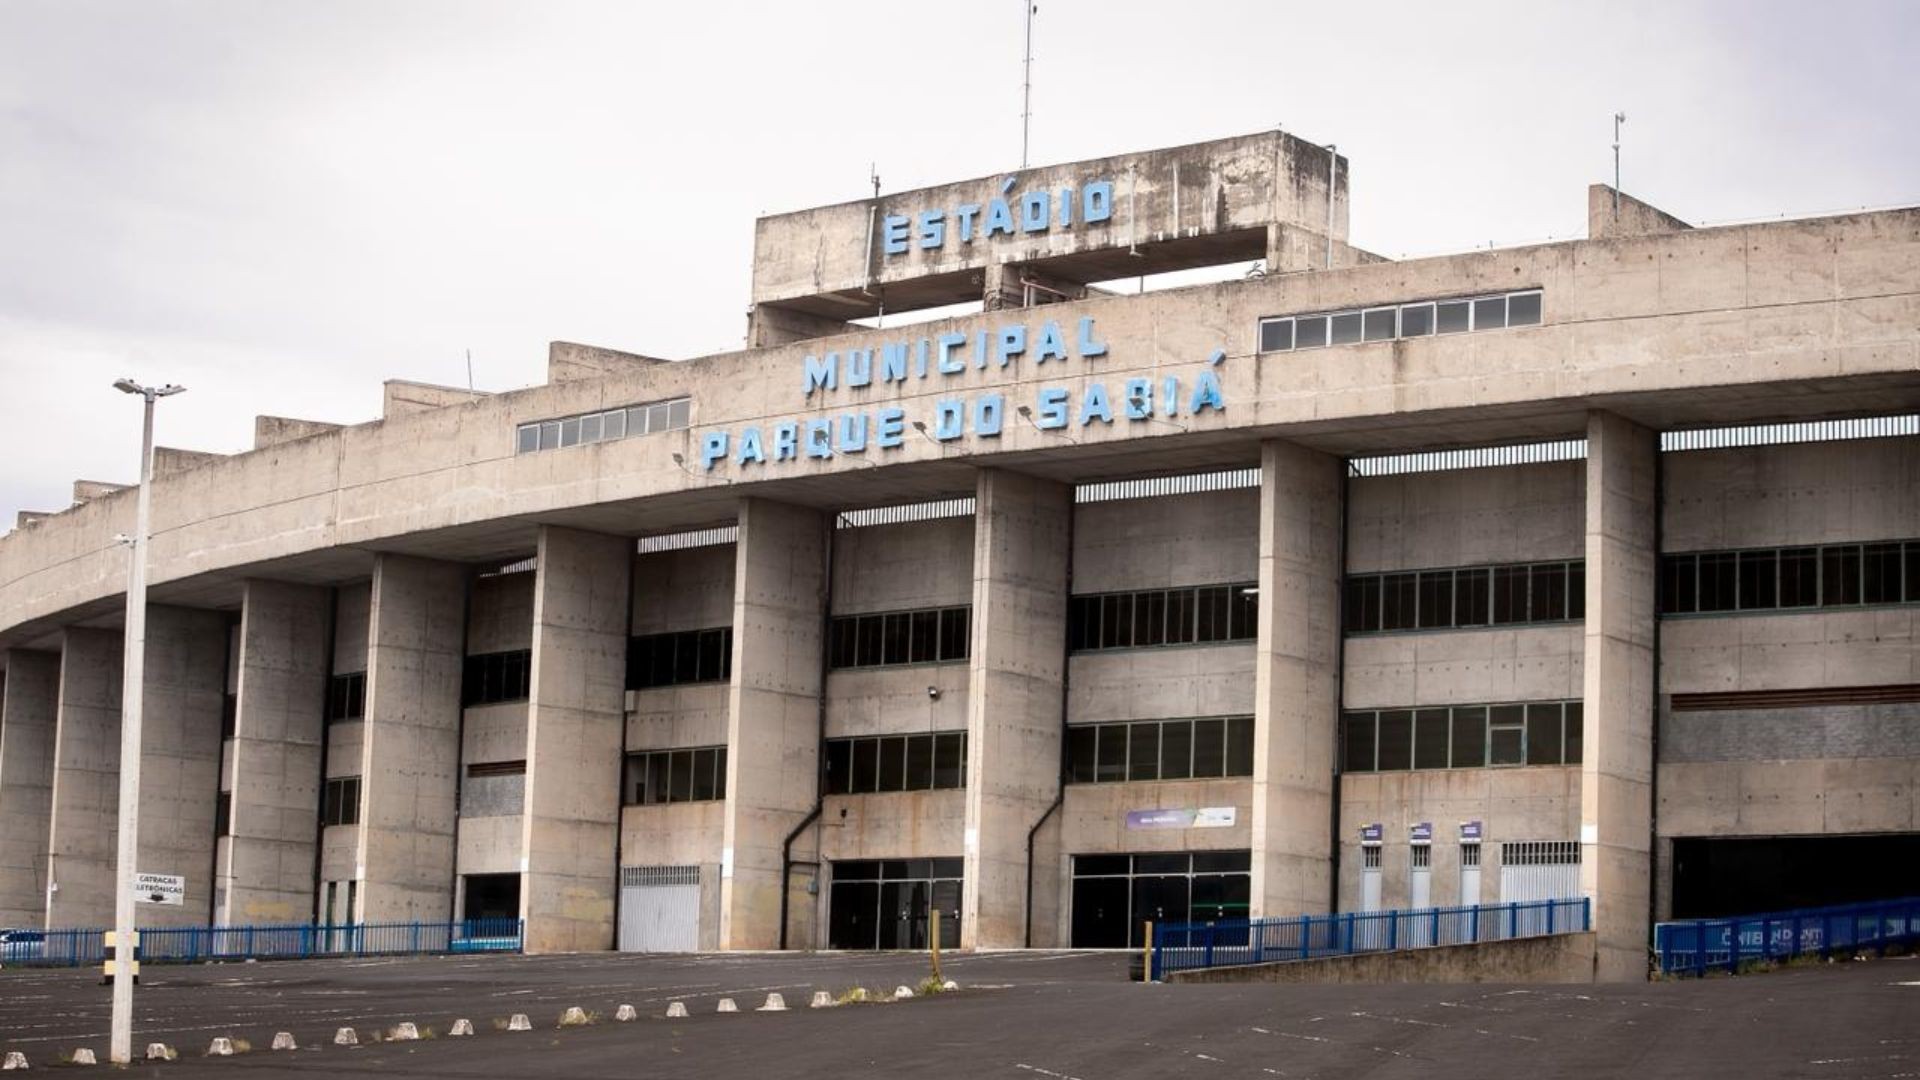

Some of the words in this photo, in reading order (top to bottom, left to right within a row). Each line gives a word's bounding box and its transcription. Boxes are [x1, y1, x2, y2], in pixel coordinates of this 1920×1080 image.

[884, 176, 1114, 256] ESTÁDIO
[803, 316, 1107, 396] MUNICIPAL
[700, 409, 904, 471] PARQUE
[935, 391, 1004, 441] DO
[1037, 349, 1226, 430] SABIÁ
[136, 884, 182, 893] LETRÔNICAS
